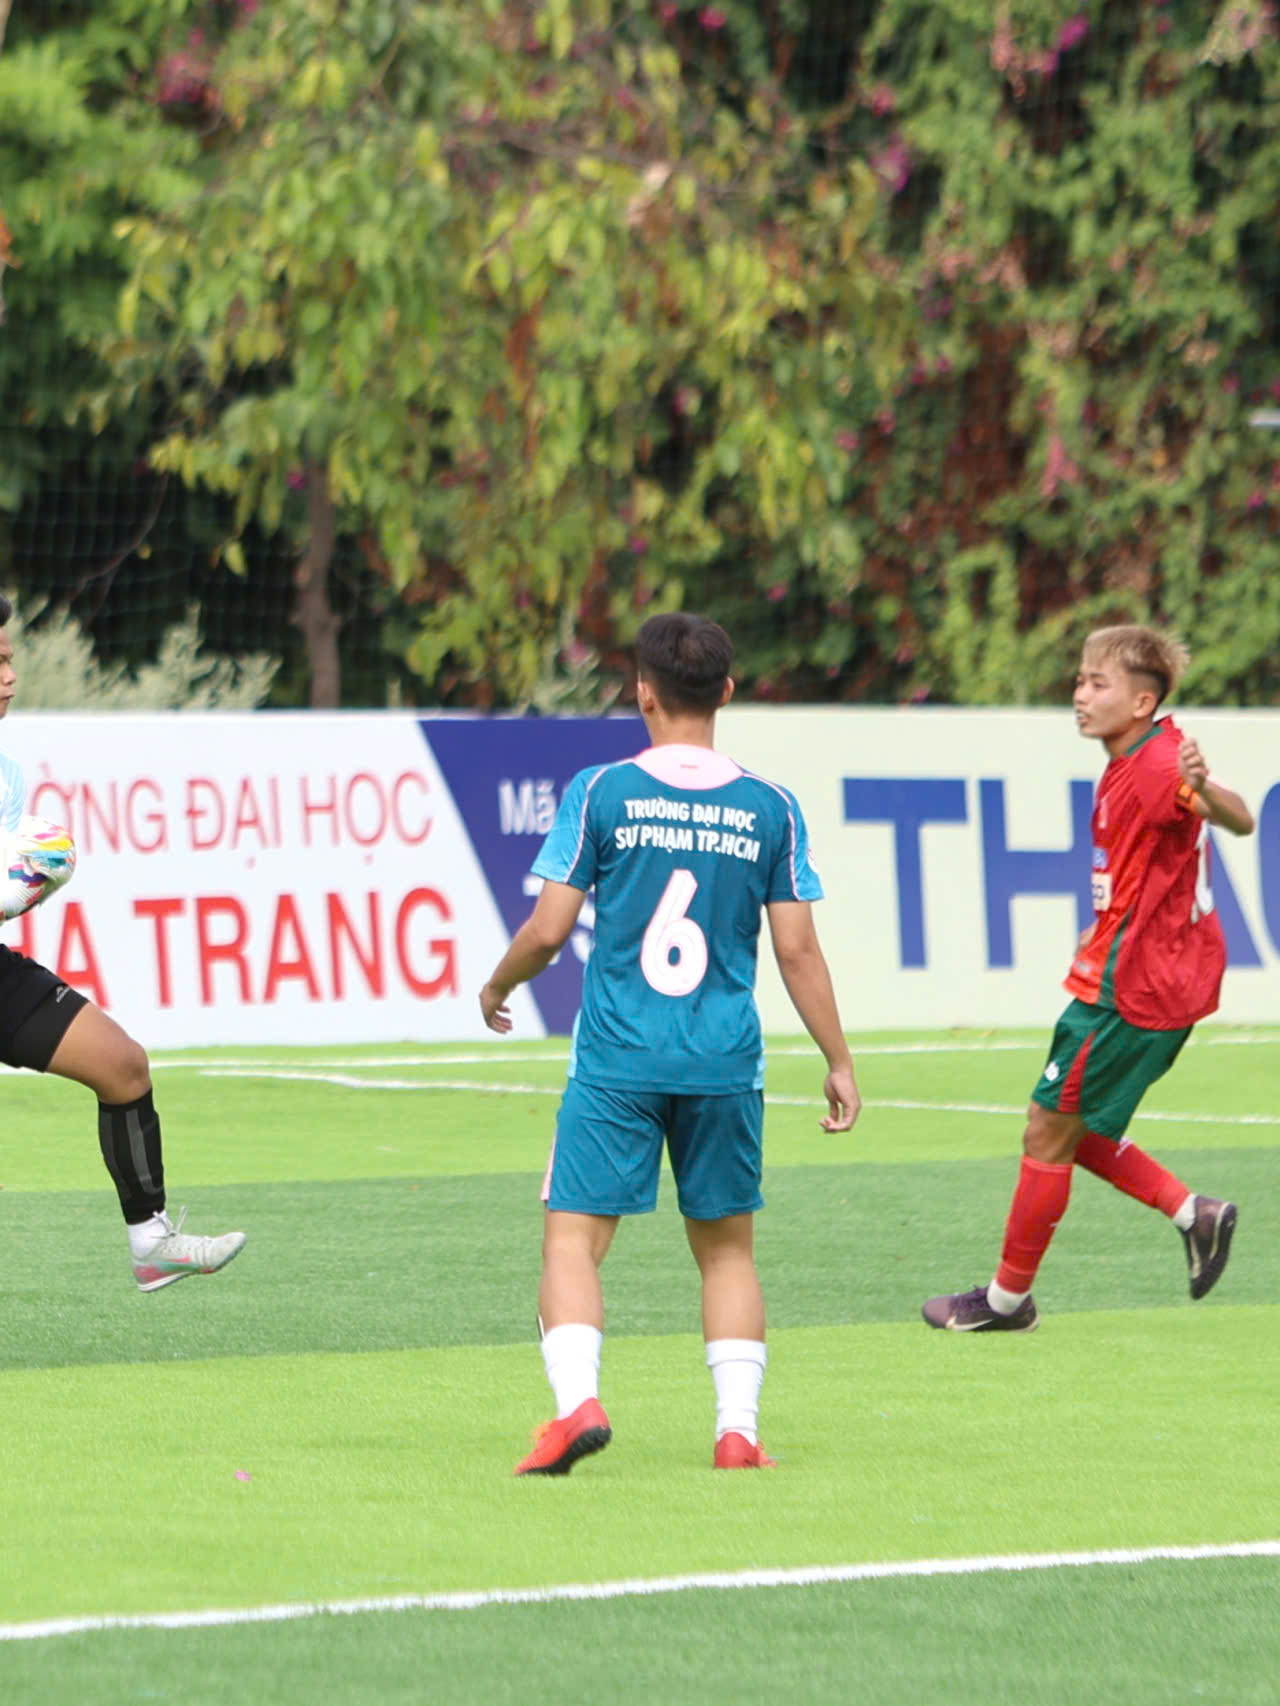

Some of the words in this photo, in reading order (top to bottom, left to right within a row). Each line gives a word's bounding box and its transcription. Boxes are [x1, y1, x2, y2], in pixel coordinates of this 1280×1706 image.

[184, 776, 283, 870] ĐẠI
[302, 769, 434, 864] HỌC
[614, 825, 639, 850] SƯ
[639, 824, 694, 853] PHẠM
[695, 829, 761, 863] TP.HCM
[691, 802, 721, 828] ĐẠI
[722, 806, 757, 832] HỌC
[132, 886, 460, 1010] TRANG
[641, 869, 708, 996] 6
